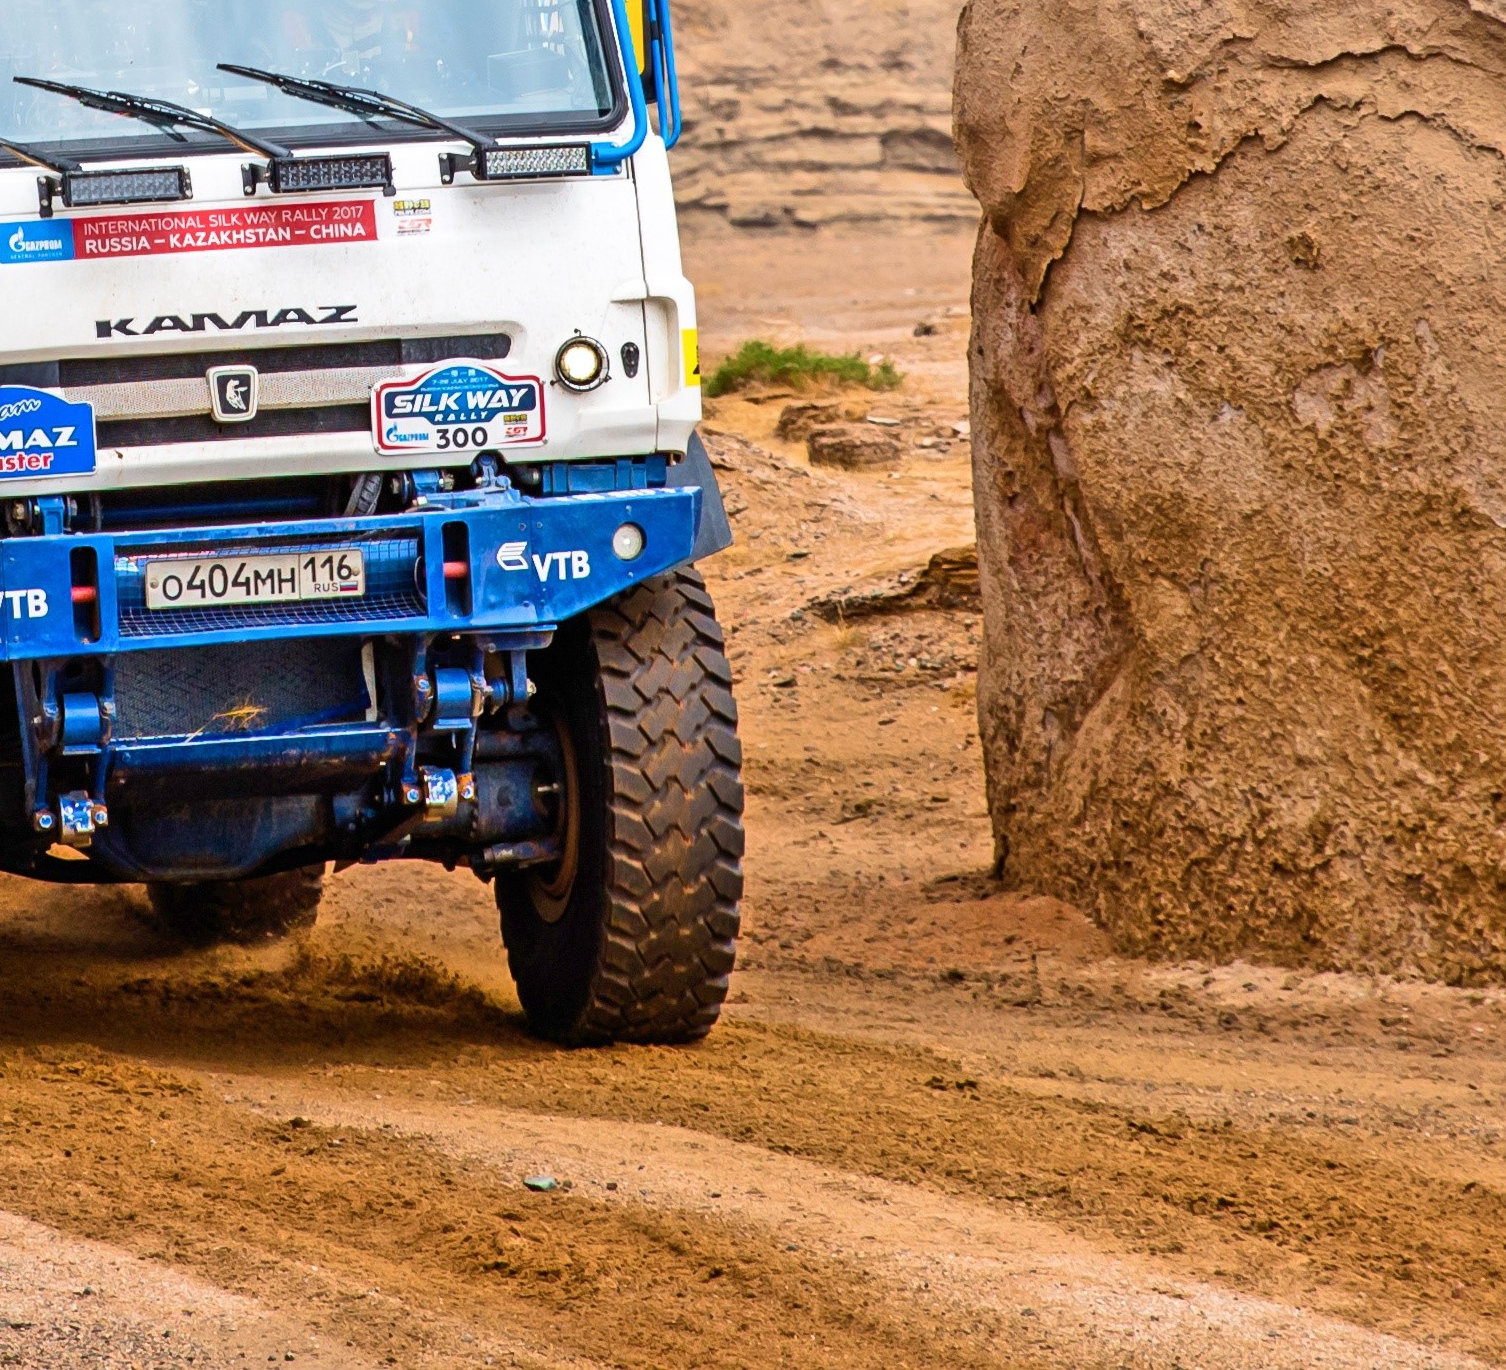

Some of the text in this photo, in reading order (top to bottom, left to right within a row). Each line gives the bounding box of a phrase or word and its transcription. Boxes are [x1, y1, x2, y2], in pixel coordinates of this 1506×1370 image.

[84, 205, 364, 236] INTERNATIONAL SILK WAY RALLY 2017
[85, 236, 151, 254] RUSSIA
[169, 226, 291, 248] KAZAKHSTAN
[310, 222, 366, 239] CHINA
[95, 305, 358, 338] KAMAZ
[392, 388, 529, 414] SILK WAY
[434, 410, 489, 422] RALLY
[436, 426, 488, 449] 300
[303, 554, 352, 582] 116
[532, 550, 591, 582] VTB
[314, 582, 339, 593] RUS
